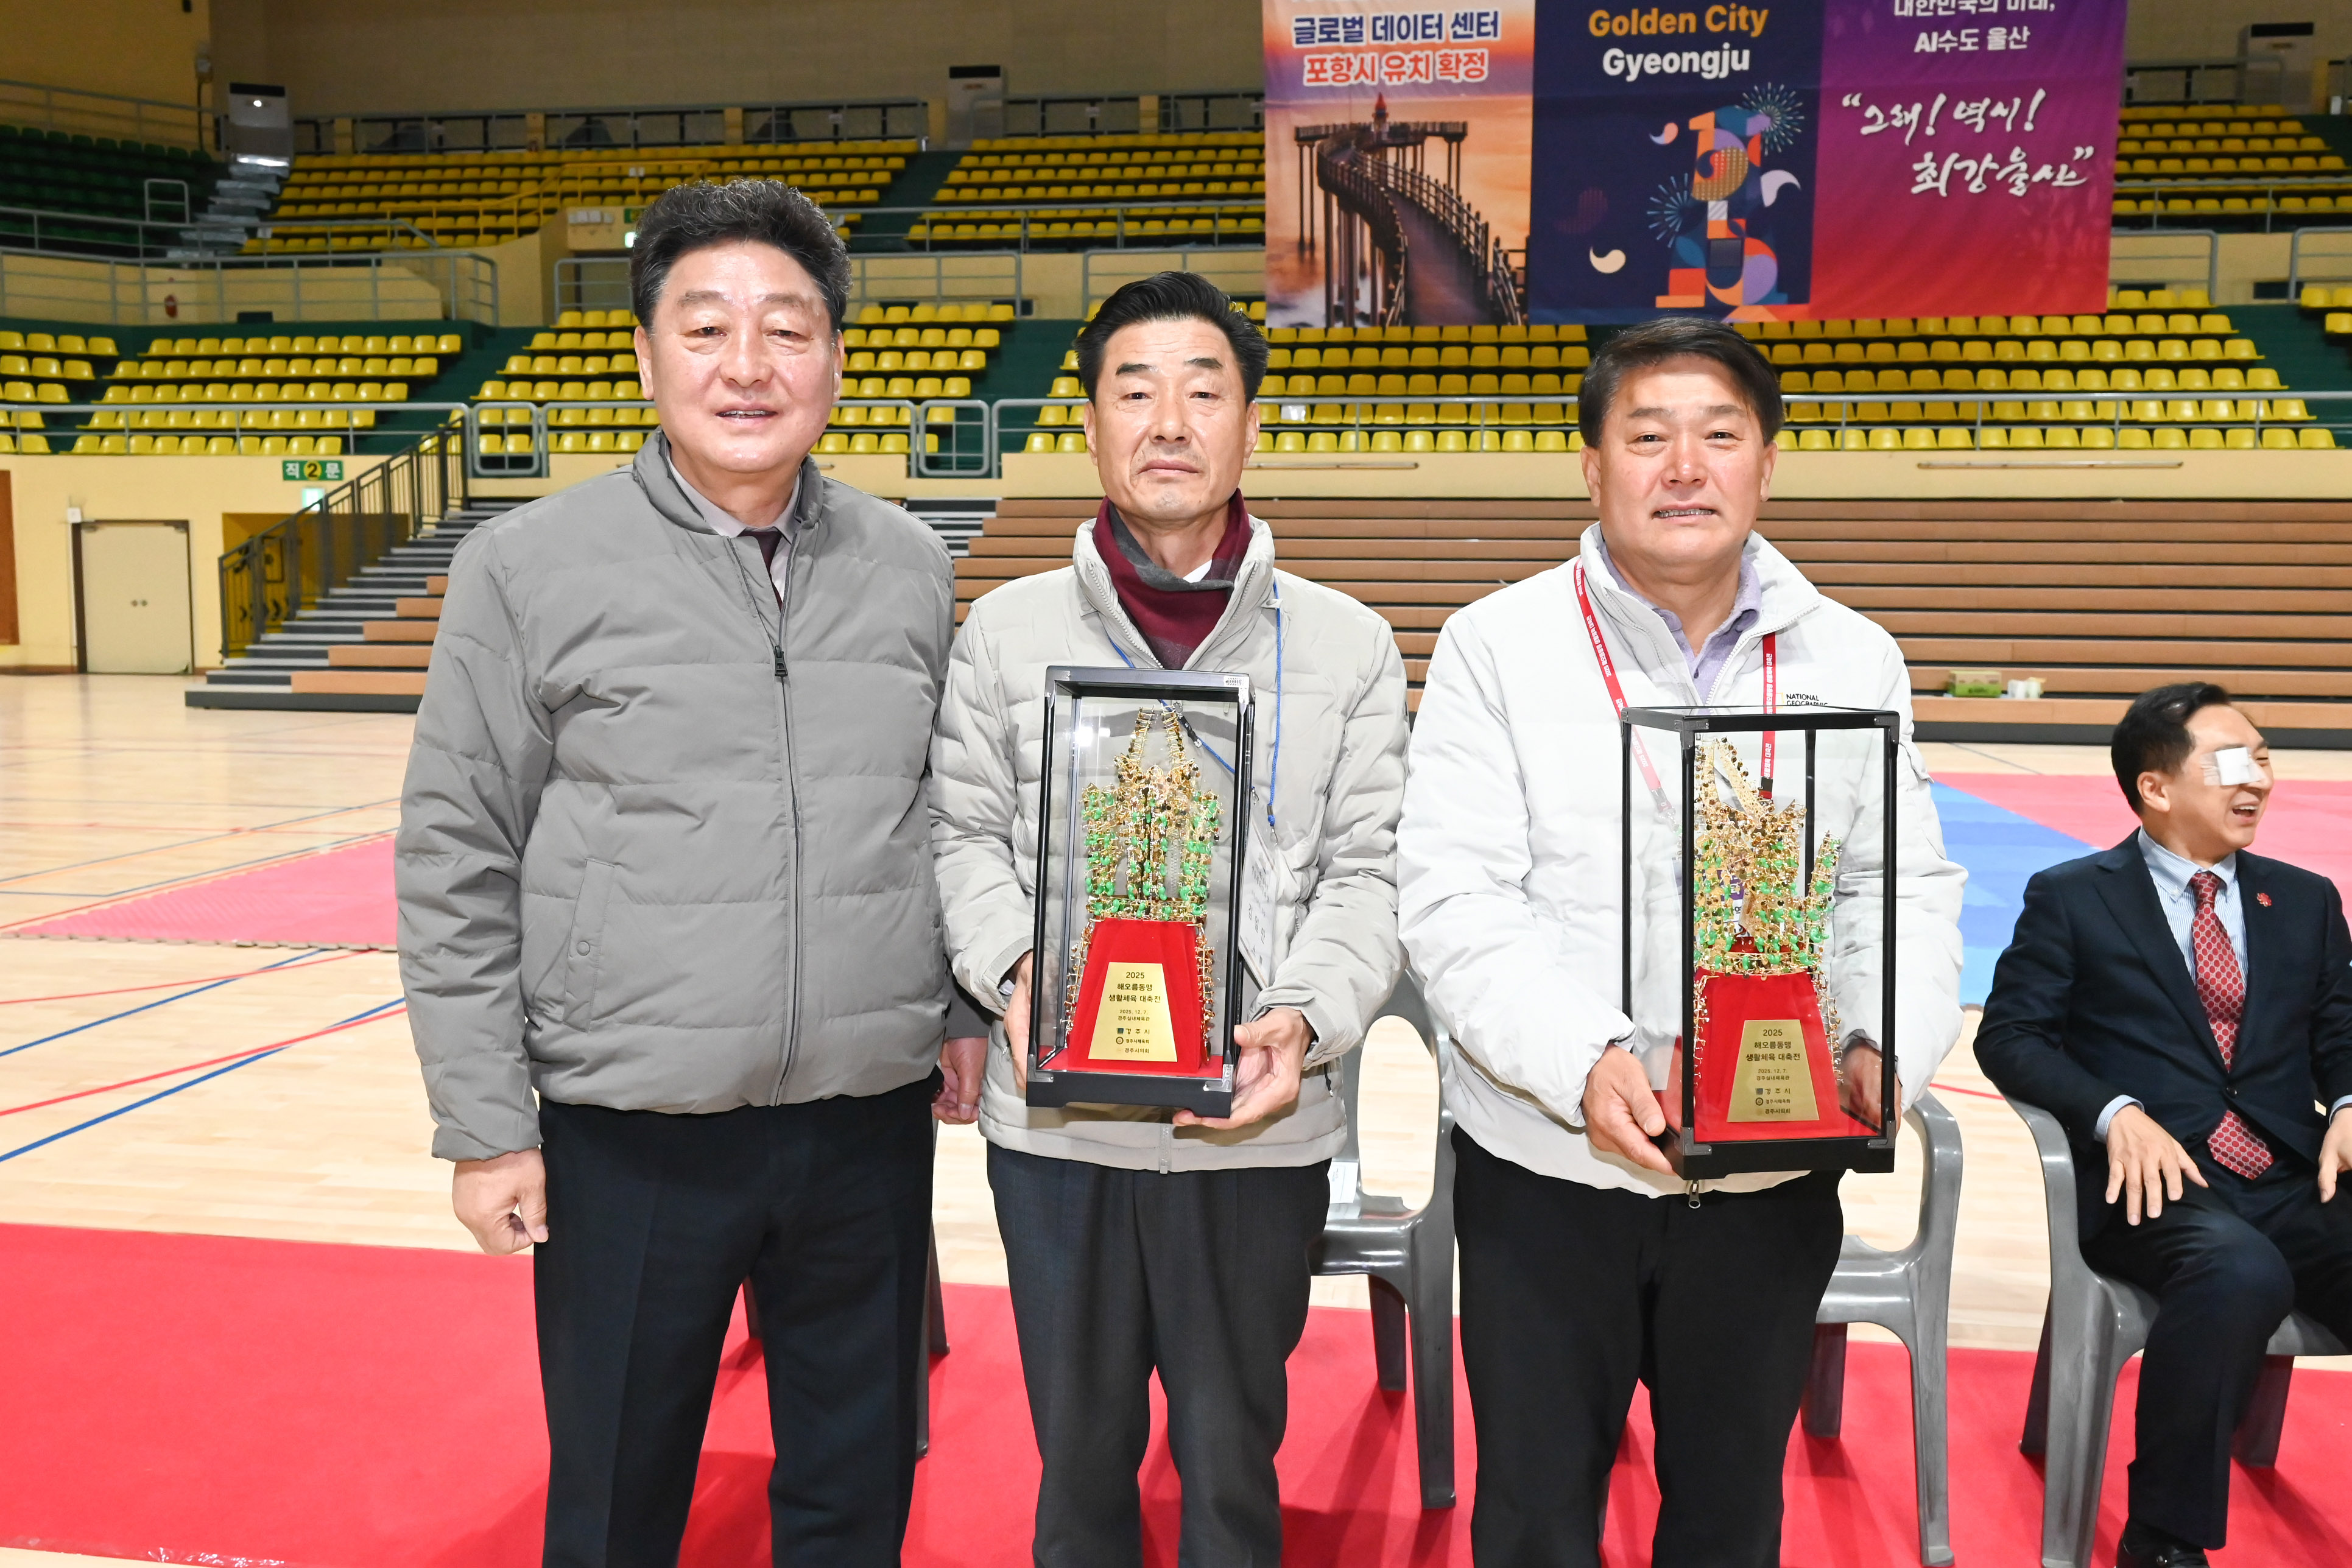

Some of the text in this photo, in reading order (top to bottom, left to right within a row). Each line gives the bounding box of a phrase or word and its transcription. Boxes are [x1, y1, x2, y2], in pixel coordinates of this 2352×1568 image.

[1294, 10, 1499, 45] 글로벌 데이터 센터
[1588, 2, 1769, 37] Golden City
[1914, 26, 2031, 53] AI수도 울산
[1306, 51, 1487, 83] 포항시 유치 확정
[1602, 42, 1750, 82] Gyeongju
[1952, 88, 2046, 133] 역시!
[307, 463, 317, 478] 2
[1603, 664, 1612, 677] 2025
[1754, 1041, 1792, 1049] 해오름동맹
